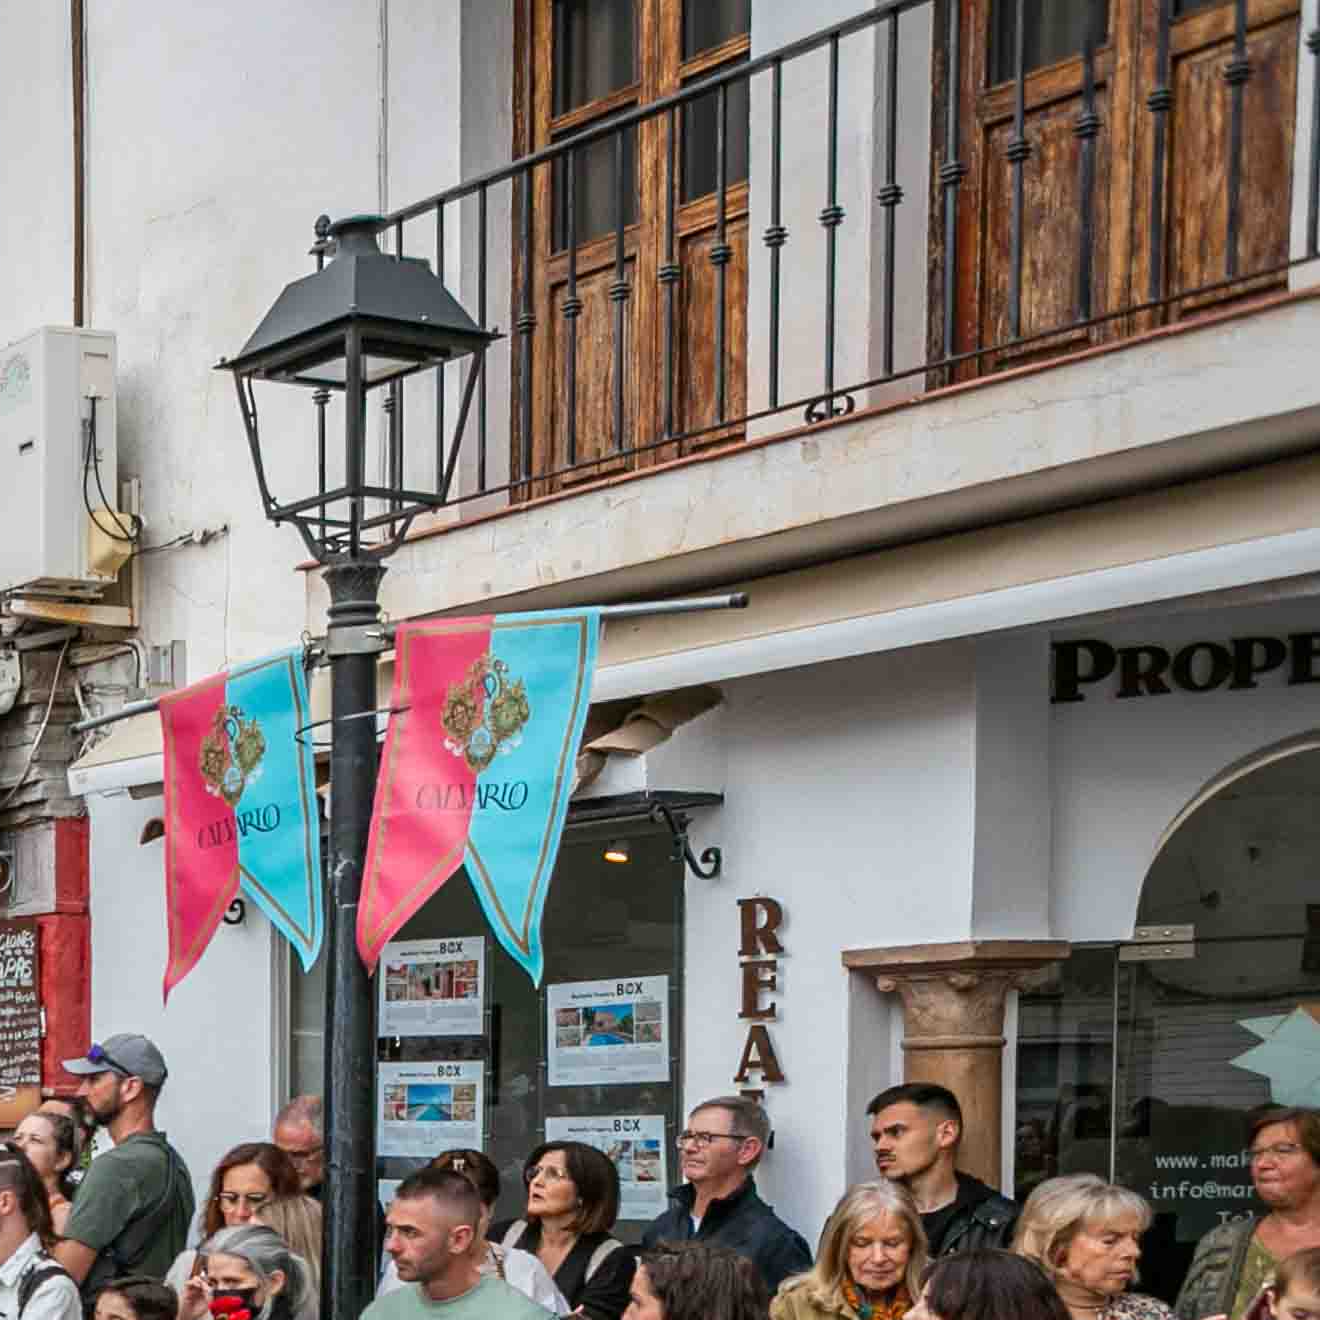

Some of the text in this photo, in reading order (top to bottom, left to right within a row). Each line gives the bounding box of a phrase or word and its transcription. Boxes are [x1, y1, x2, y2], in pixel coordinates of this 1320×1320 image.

[416, 781, 529, 811] CALVARIO
[198, 803, 281, 849] CALVARIO
[440, 941, 463, 954] BOX
[617, 982, 644, 996] BOX
[734, 897, 785, 1150] REA
[438, 1064, 461, 1077] BOX
[614, 1119, 640, 1132] BOX
